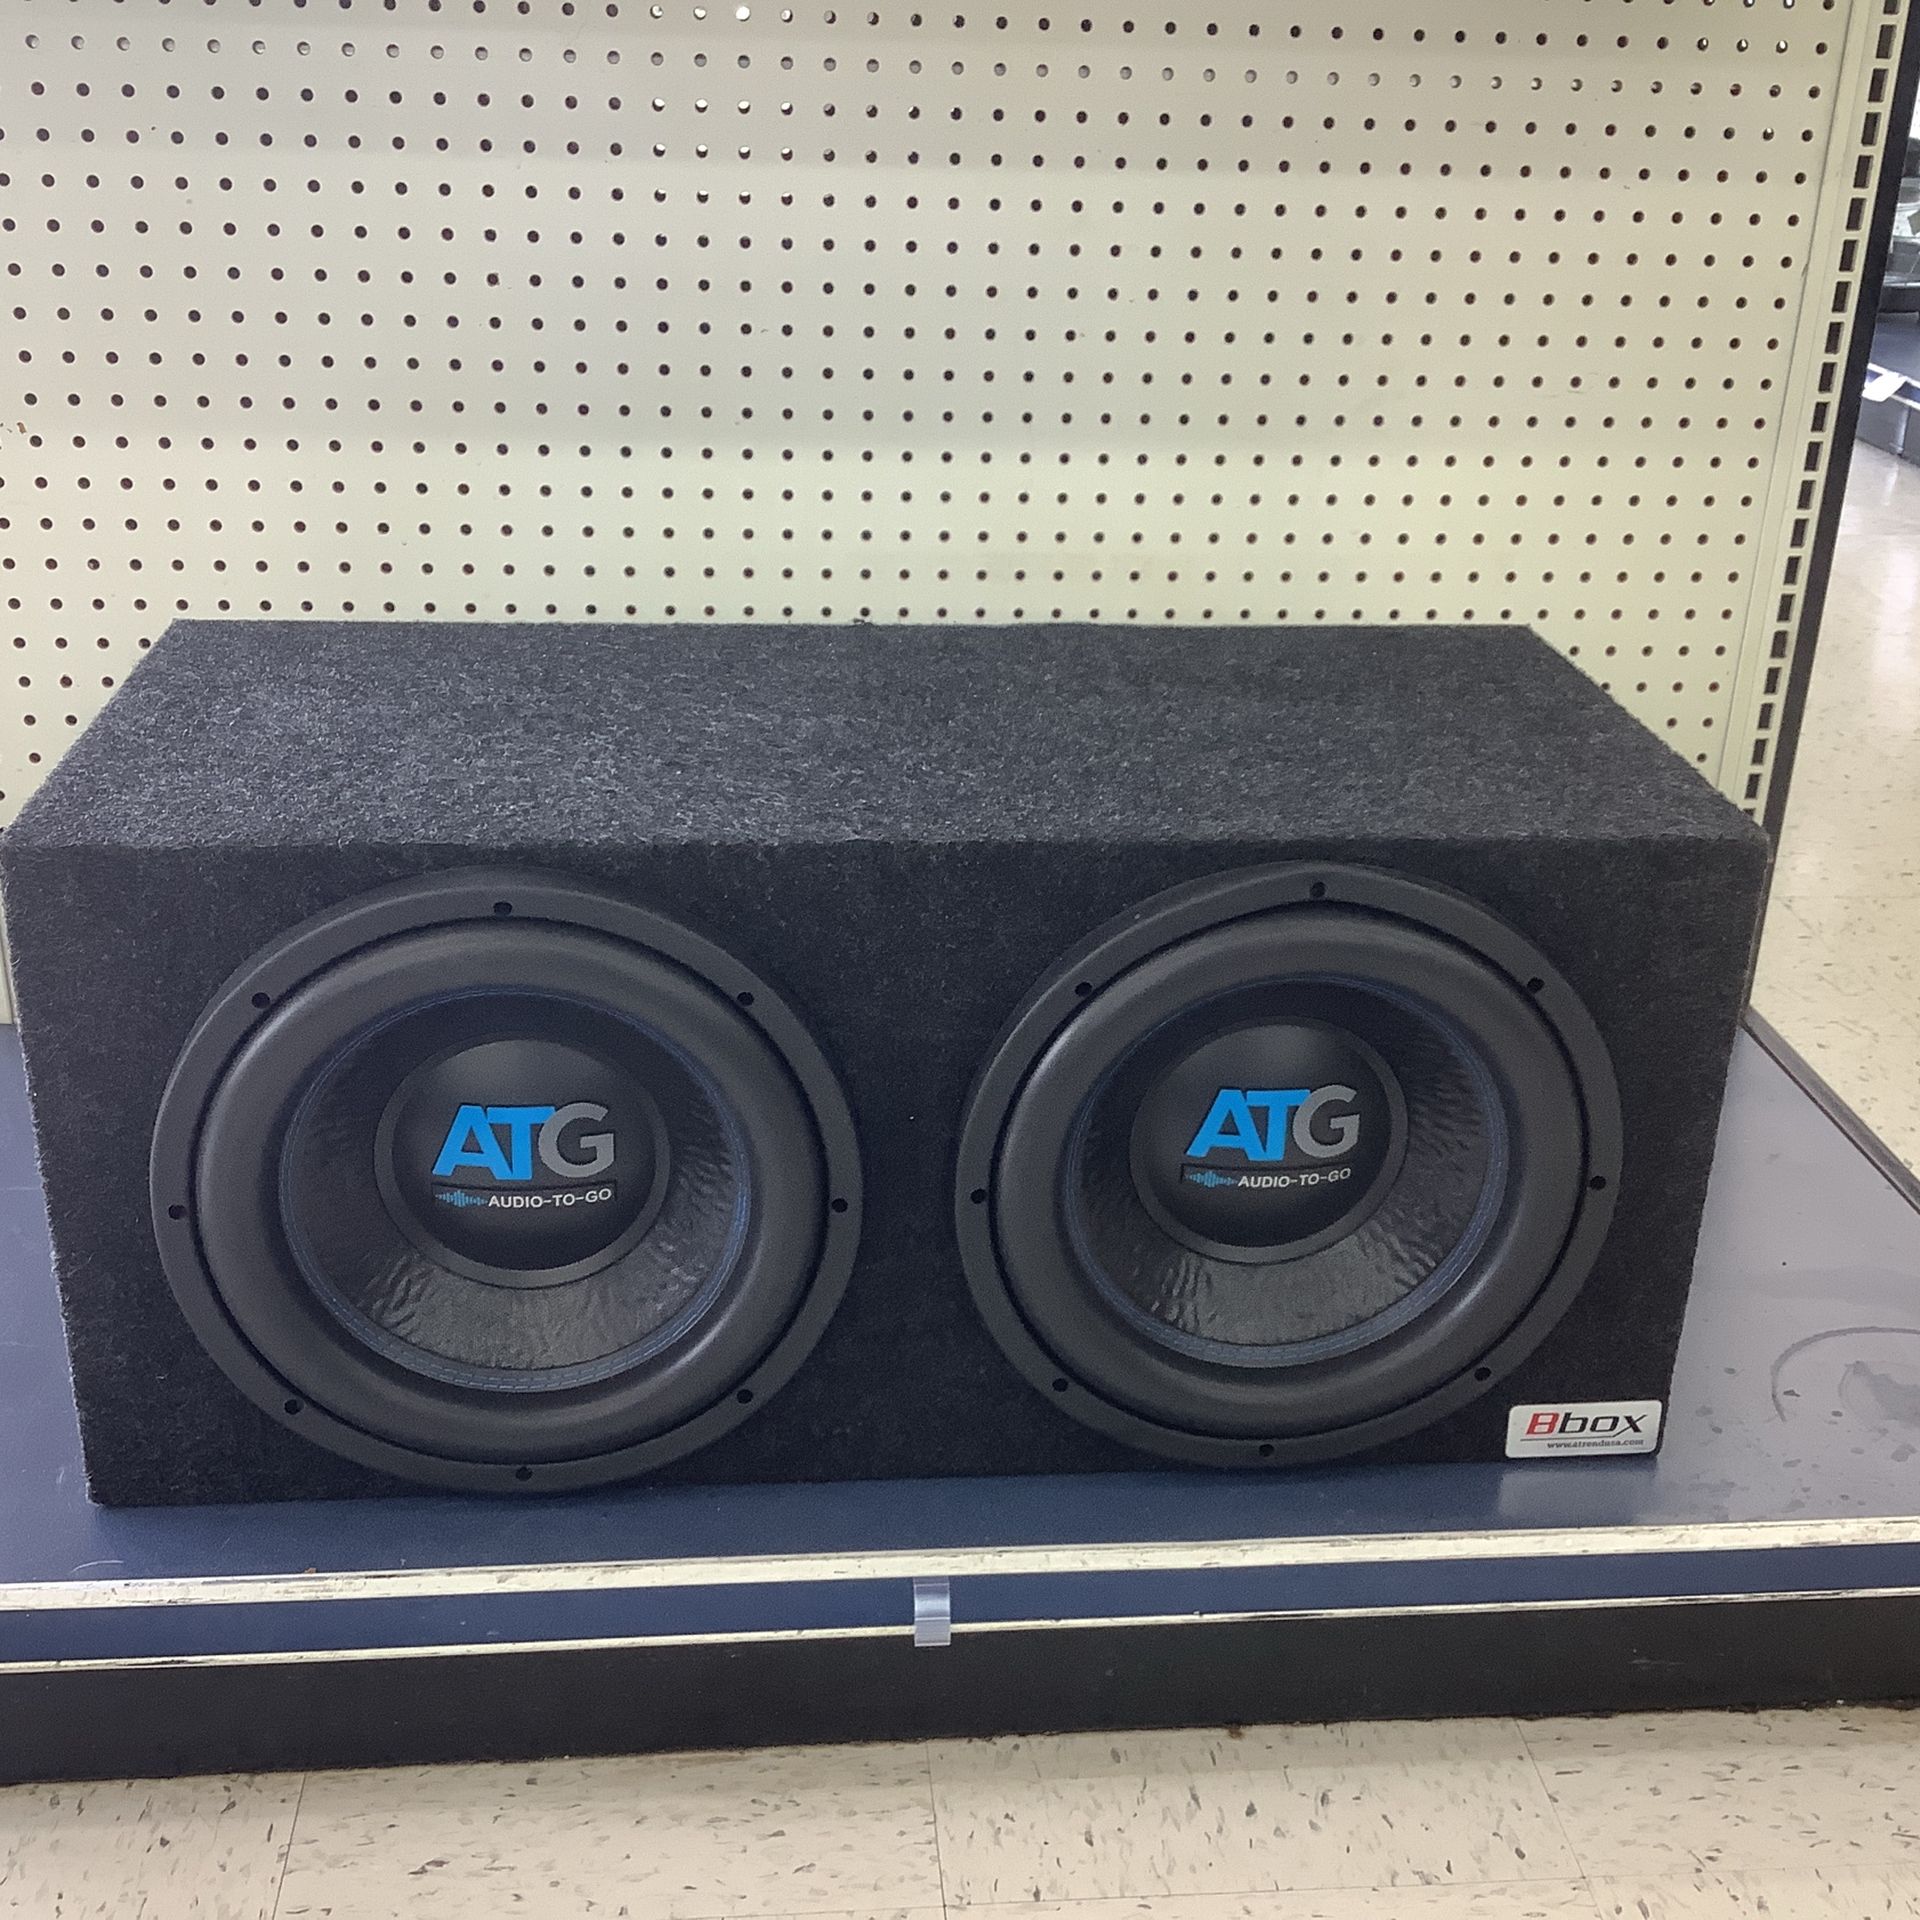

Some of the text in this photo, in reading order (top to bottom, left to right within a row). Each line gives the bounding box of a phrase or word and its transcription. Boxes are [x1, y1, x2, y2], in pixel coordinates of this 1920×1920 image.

[1186, 1084, 1360, 1162] ATG
[432, 1102, 614, 1180] ATG
[1238, 1168, 1351, 1188] AUDIO-TO-GO
[488, 1188, 612, 1208] AUDIO-TO-GO
[1525, 1412, 1647, 1435] Bbox
[1547, 1439, 1644, 1449] www.atrendusa.com
